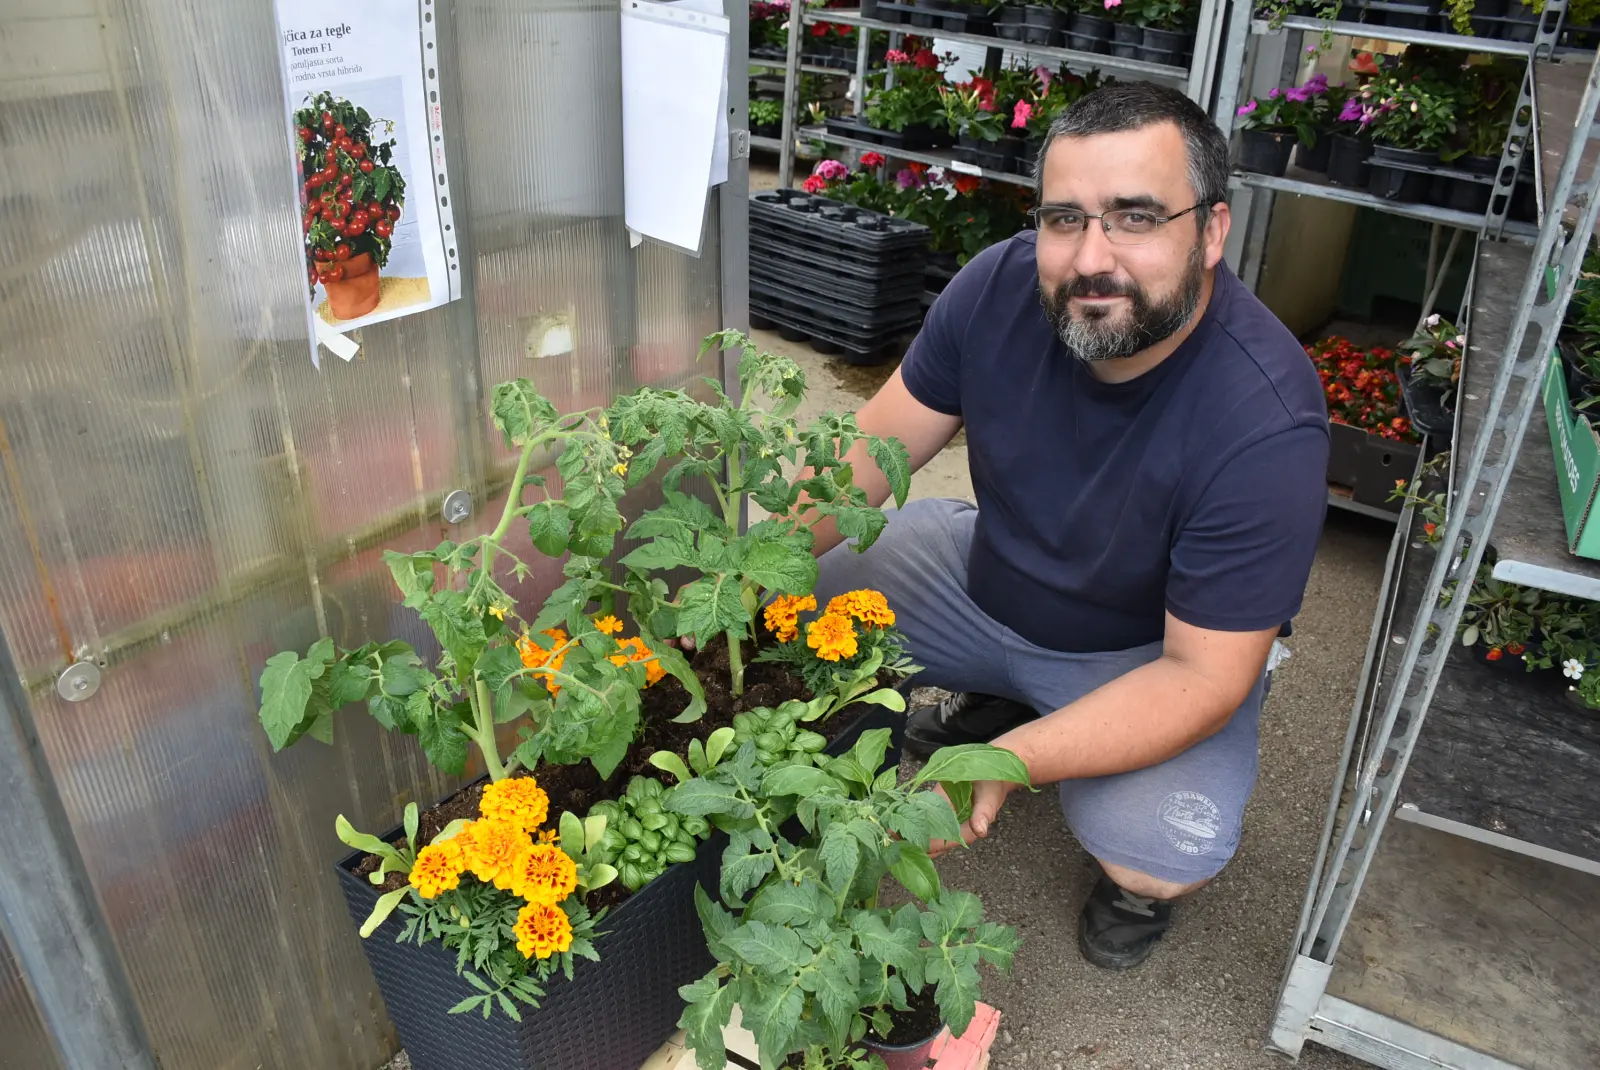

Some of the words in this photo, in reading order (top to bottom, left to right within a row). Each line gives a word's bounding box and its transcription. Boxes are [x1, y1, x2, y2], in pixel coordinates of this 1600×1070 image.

[309, 29, 323, 39] za
[325, 23, 351, 38] tegle
[291, 46, 319, 56] Totem
[320, 42, 332, 53] F1
[290, 58, 324, 72] patuljasta
[325, 56, 344, 64] sorta
[295, 72, 316, 83] rodna
[317, 69, 336, 78] vrsta
[337, 64, 363, 76] hibrida
[1175, 840, 1199, 853] 1980
